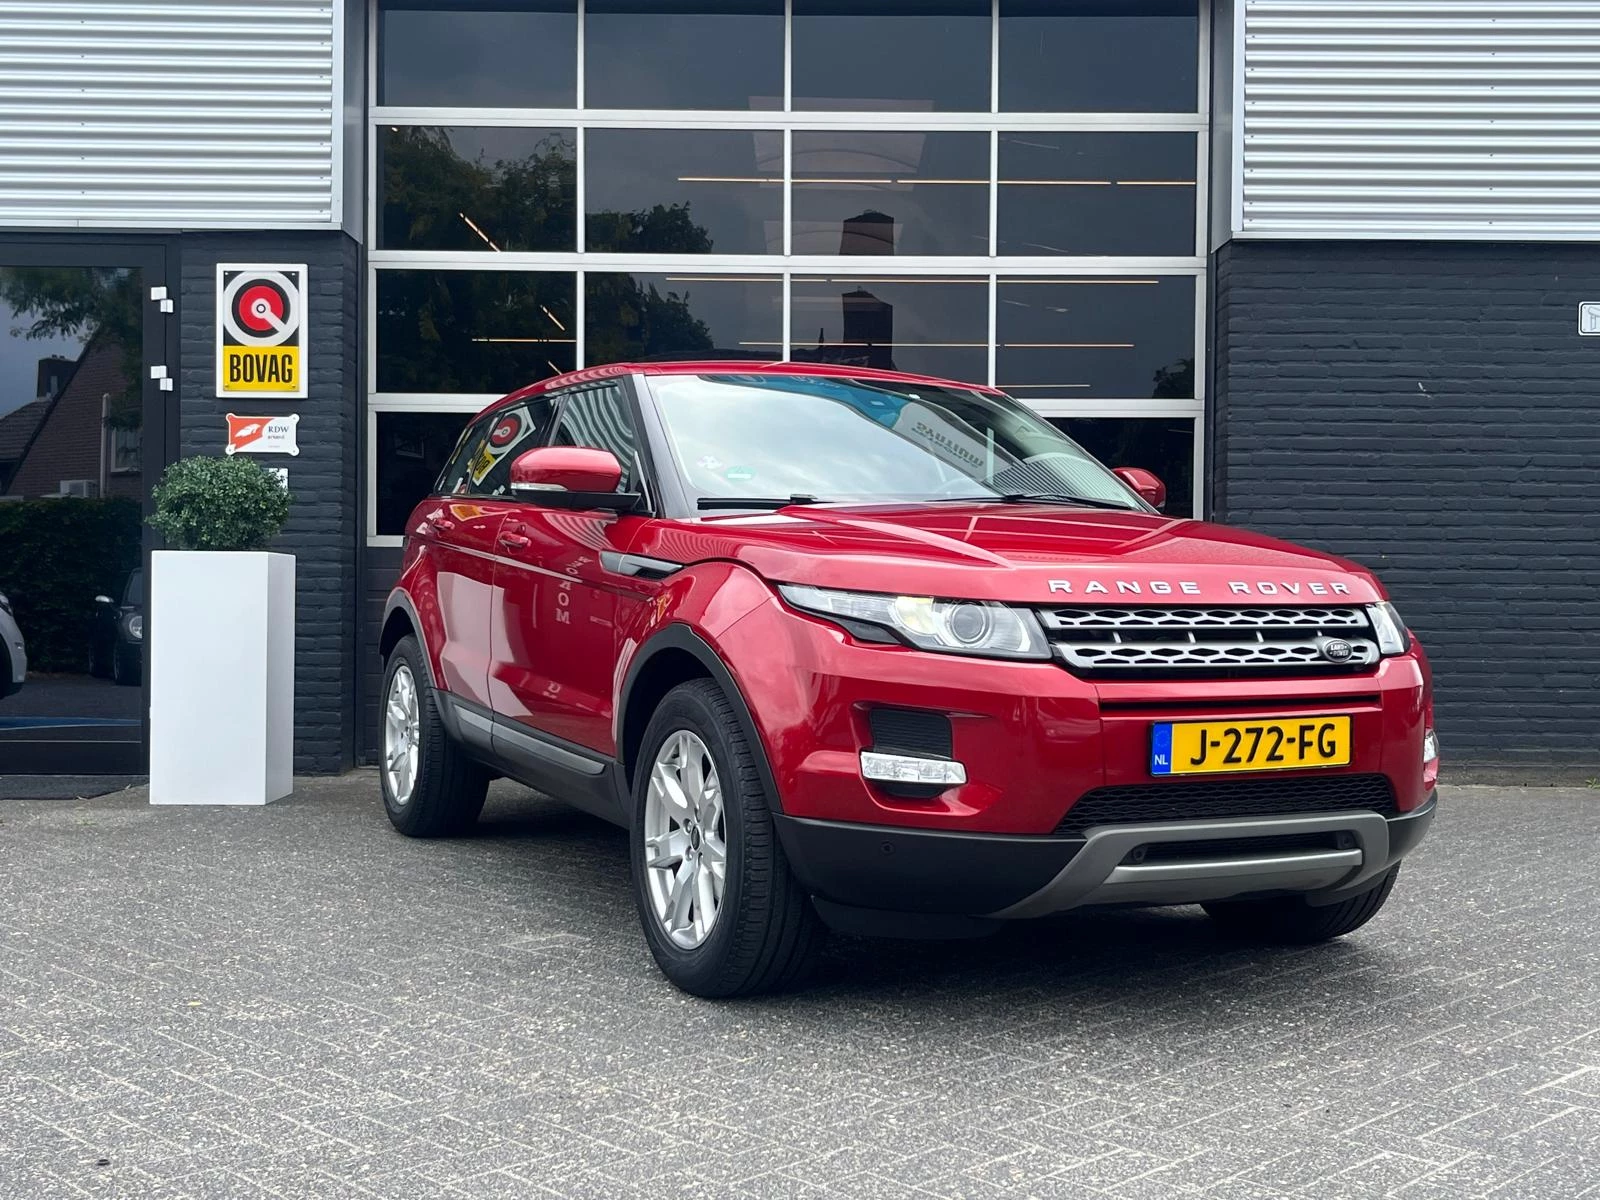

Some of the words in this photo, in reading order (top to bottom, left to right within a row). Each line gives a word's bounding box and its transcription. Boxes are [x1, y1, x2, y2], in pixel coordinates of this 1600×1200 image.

[229, 353, 293, 383] BOVAG
[268, 425, 290, 433] RDW
[1047, 579, 1202, 594] RANGE
[1227, 581, 1351, 595] ROVER
[1154, 754, 1169, 766] NL
[1190, 723, 1337, 766] J-272-FG
